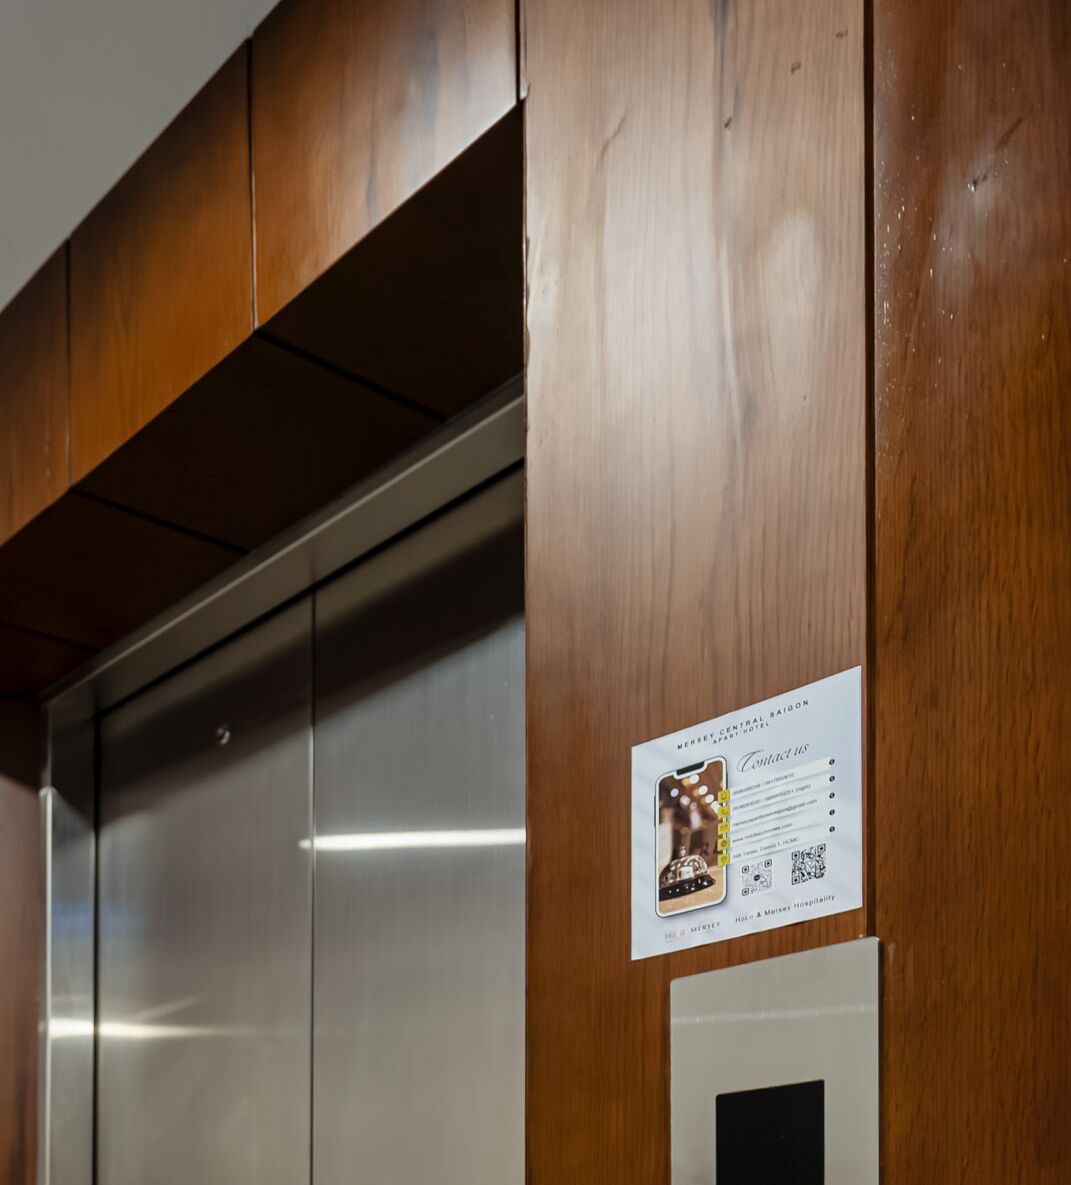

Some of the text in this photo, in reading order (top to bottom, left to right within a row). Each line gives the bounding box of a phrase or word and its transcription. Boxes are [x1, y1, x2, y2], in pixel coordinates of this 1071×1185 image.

[677, 699, 809, 750] MERSEY CENTRAL SAIGON
[737, 743, 810, 772] Contact us
[764, 905, 791, 916] Mersey
[794, 894, 835, 908] Hospitality
